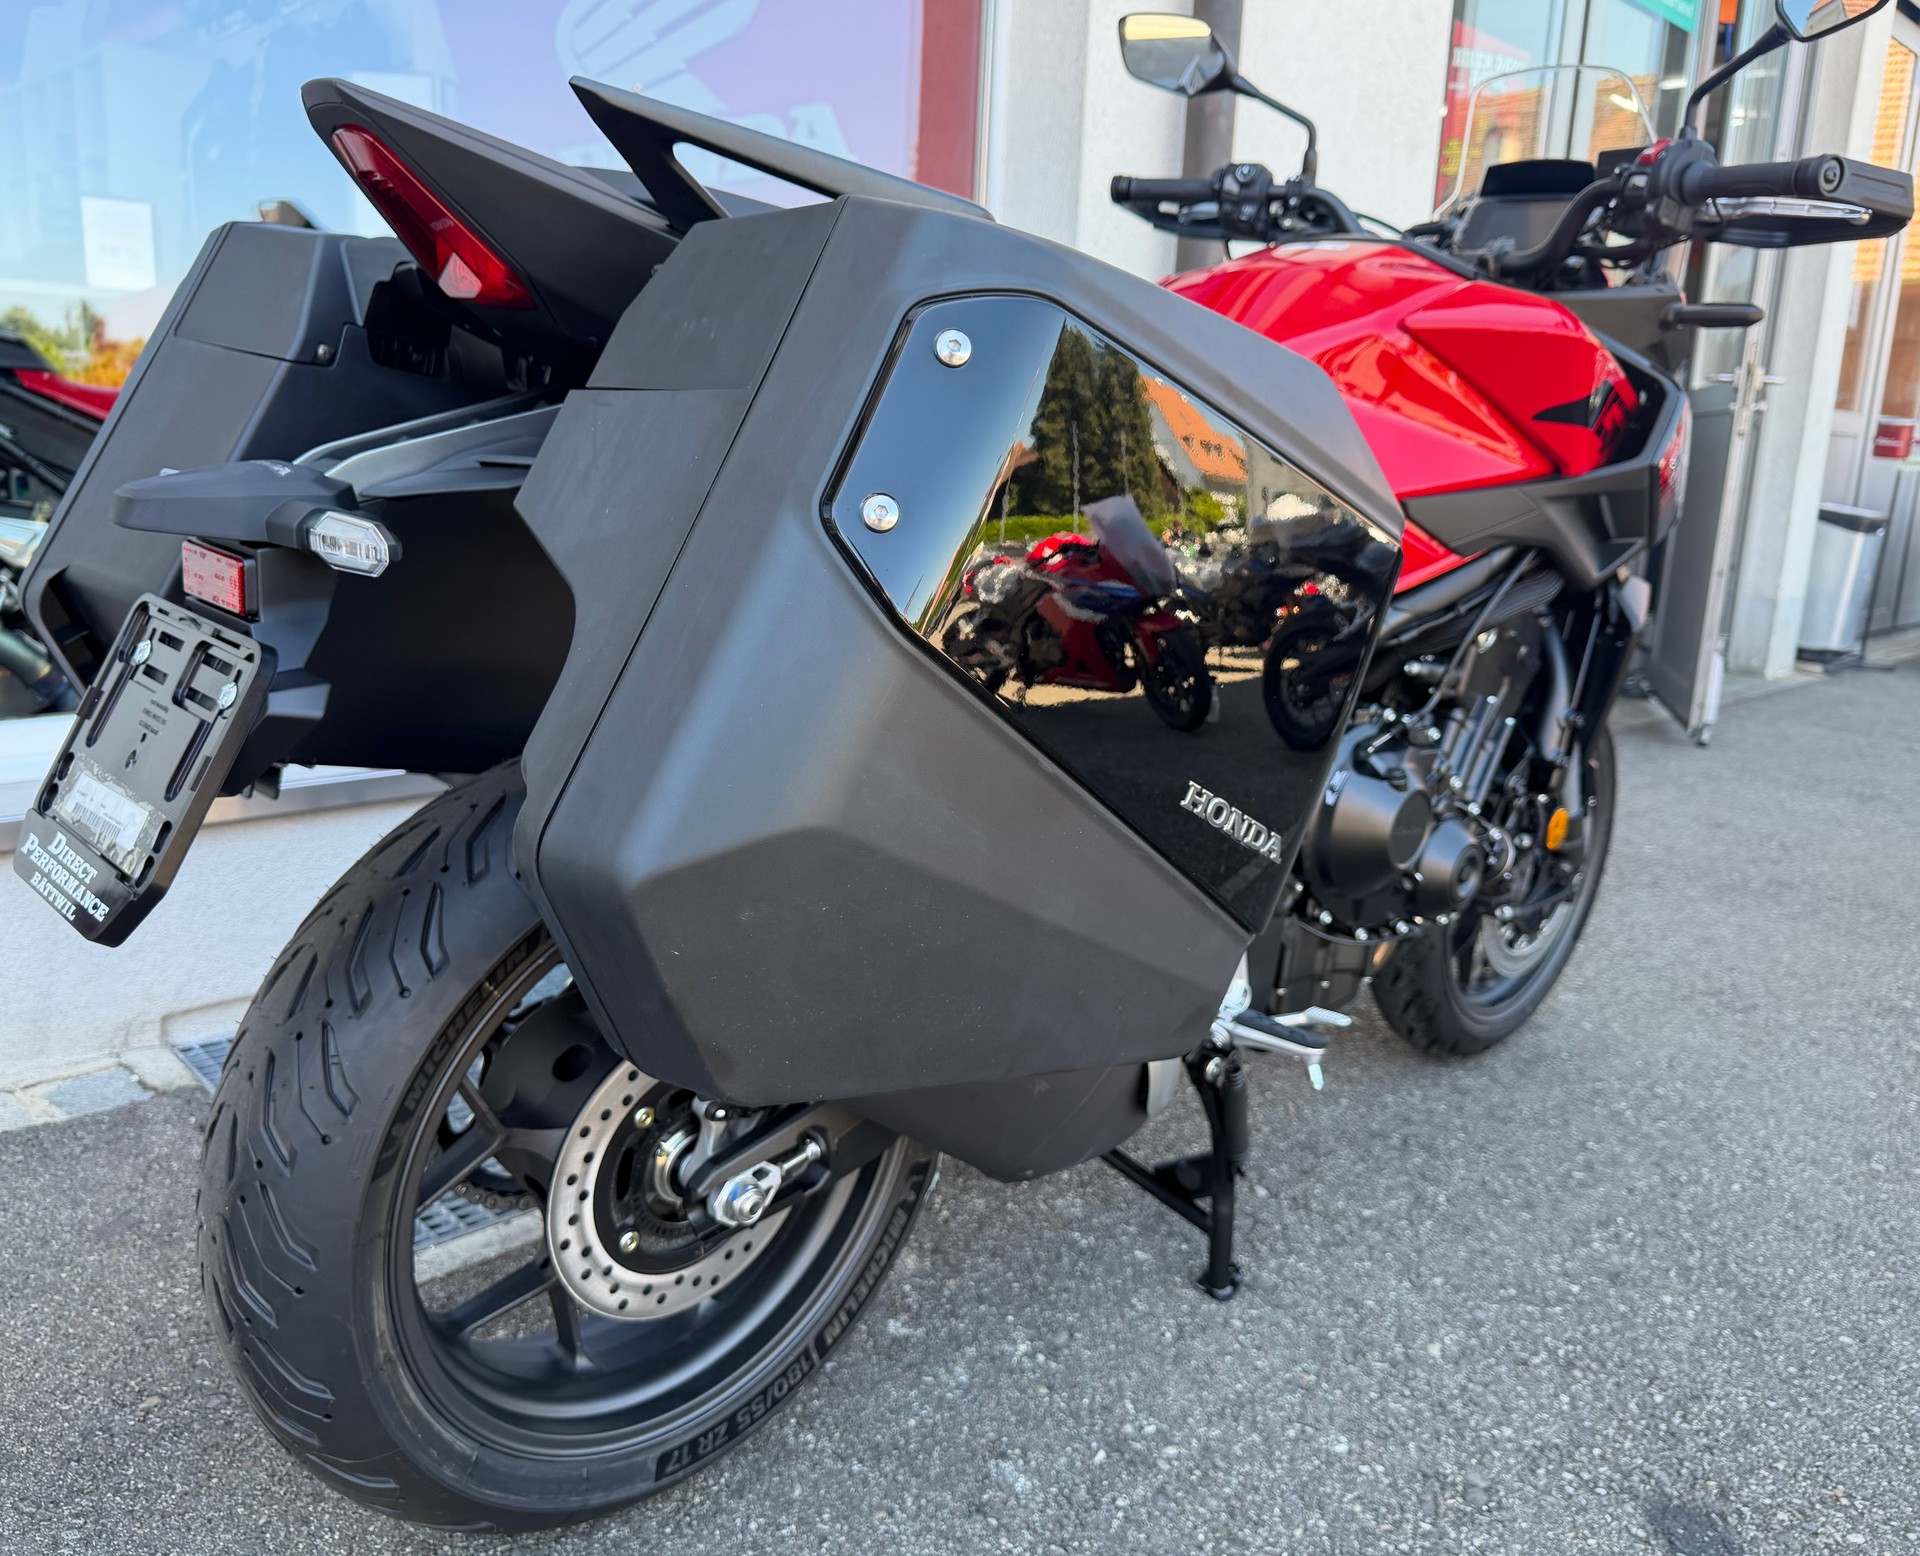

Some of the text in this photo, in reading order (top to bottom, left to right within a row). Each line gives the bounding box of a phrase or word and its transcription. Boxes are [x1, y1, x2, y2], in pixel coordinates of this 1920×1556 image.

[47, 831, 98, 884] DIRECT
[1180, 780, 1282, 864] HONDA
[20, 832, 110, 922] PERFORMANCE
[30, 871, 77, 921] BÄTTWIL
[822, 1206, 909, 1347] MICHELIN
[664, 1353, 813, 1474] 180/55 ZR 17
